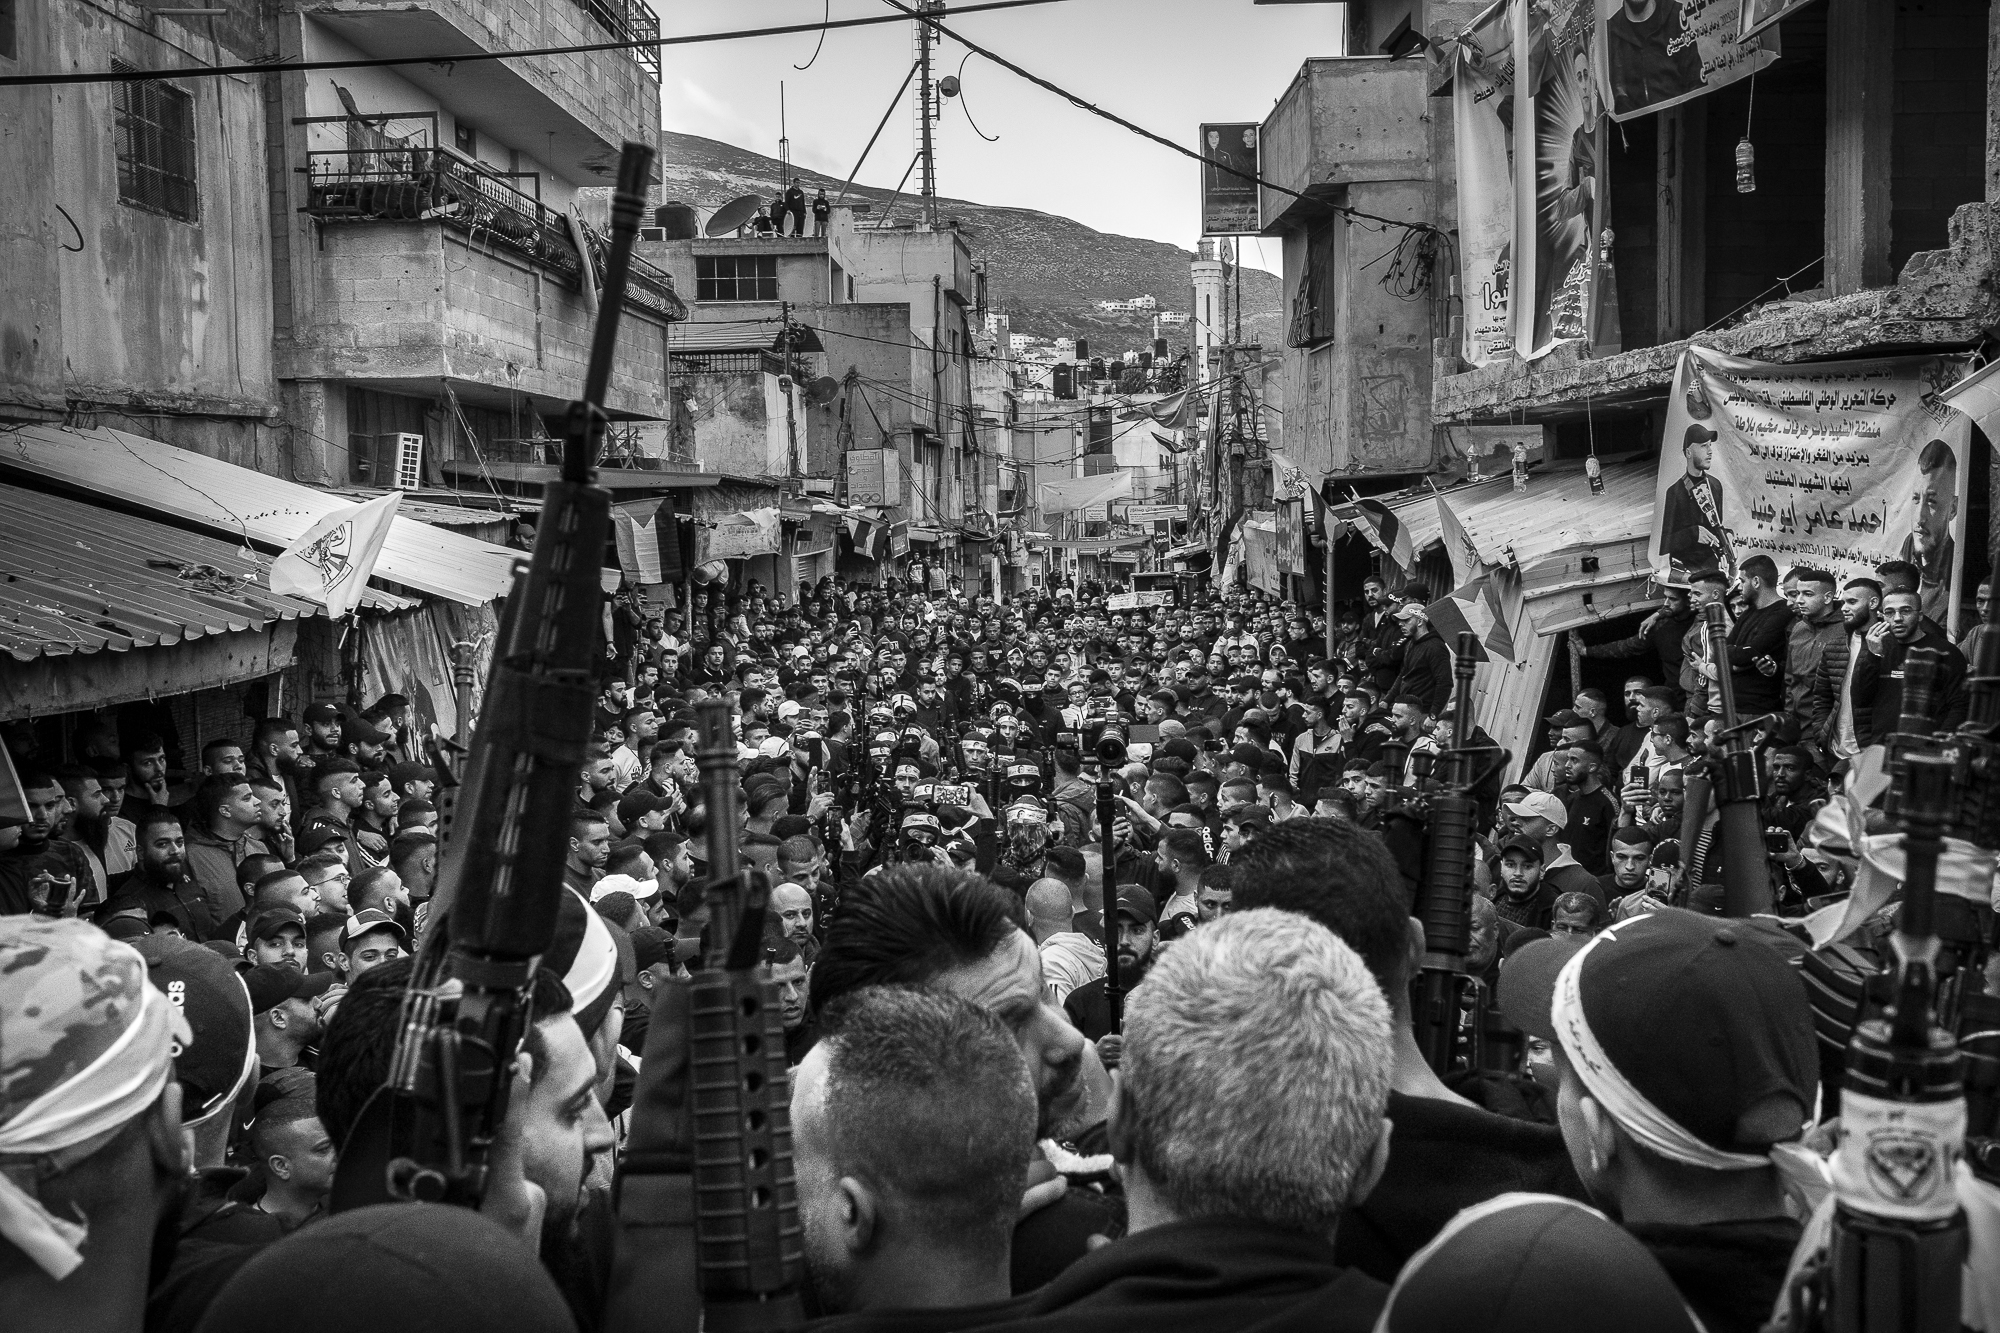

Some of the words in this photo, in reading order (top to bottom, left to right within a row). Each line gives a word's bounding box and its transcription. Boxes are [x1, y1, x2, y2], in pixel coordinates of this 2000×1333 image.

[1779, 390, 1814, 413] الفلسطيني
[1815, 390, 1839, 413] الوطني
[1840, 389, 1869, 411] التحرير
[1870, 388, 1897, 410] حركة
[1735, 415, 1755, 437] بلاطة
[1756, 418, 1778, 437] مخيم
[1783, 419, 1808, 439] عرفات
[1808, 421, 1828, 440] ياسر
[1829, 419, 1853, 441] الشهيد
[1855, 420, 1881, 438] منطقة
[1812, 448, 1831, 464] الفخر
[1833, 451, 1843, 465] من
[1845, 450, 1870, 467] بمزيد
[1765, 469, 1798, 489] المشتبك
[1799, 472, 1828, 493] الشهيد
[1829, 475, 1853, 495] ابنها
[1751, 495, 1776, 532] جنيد
[1779, 493, 1798, 534] أبو
[1804, 502, 1844, 535] عامر
[1848, 498, 1886, 535] أحمد
